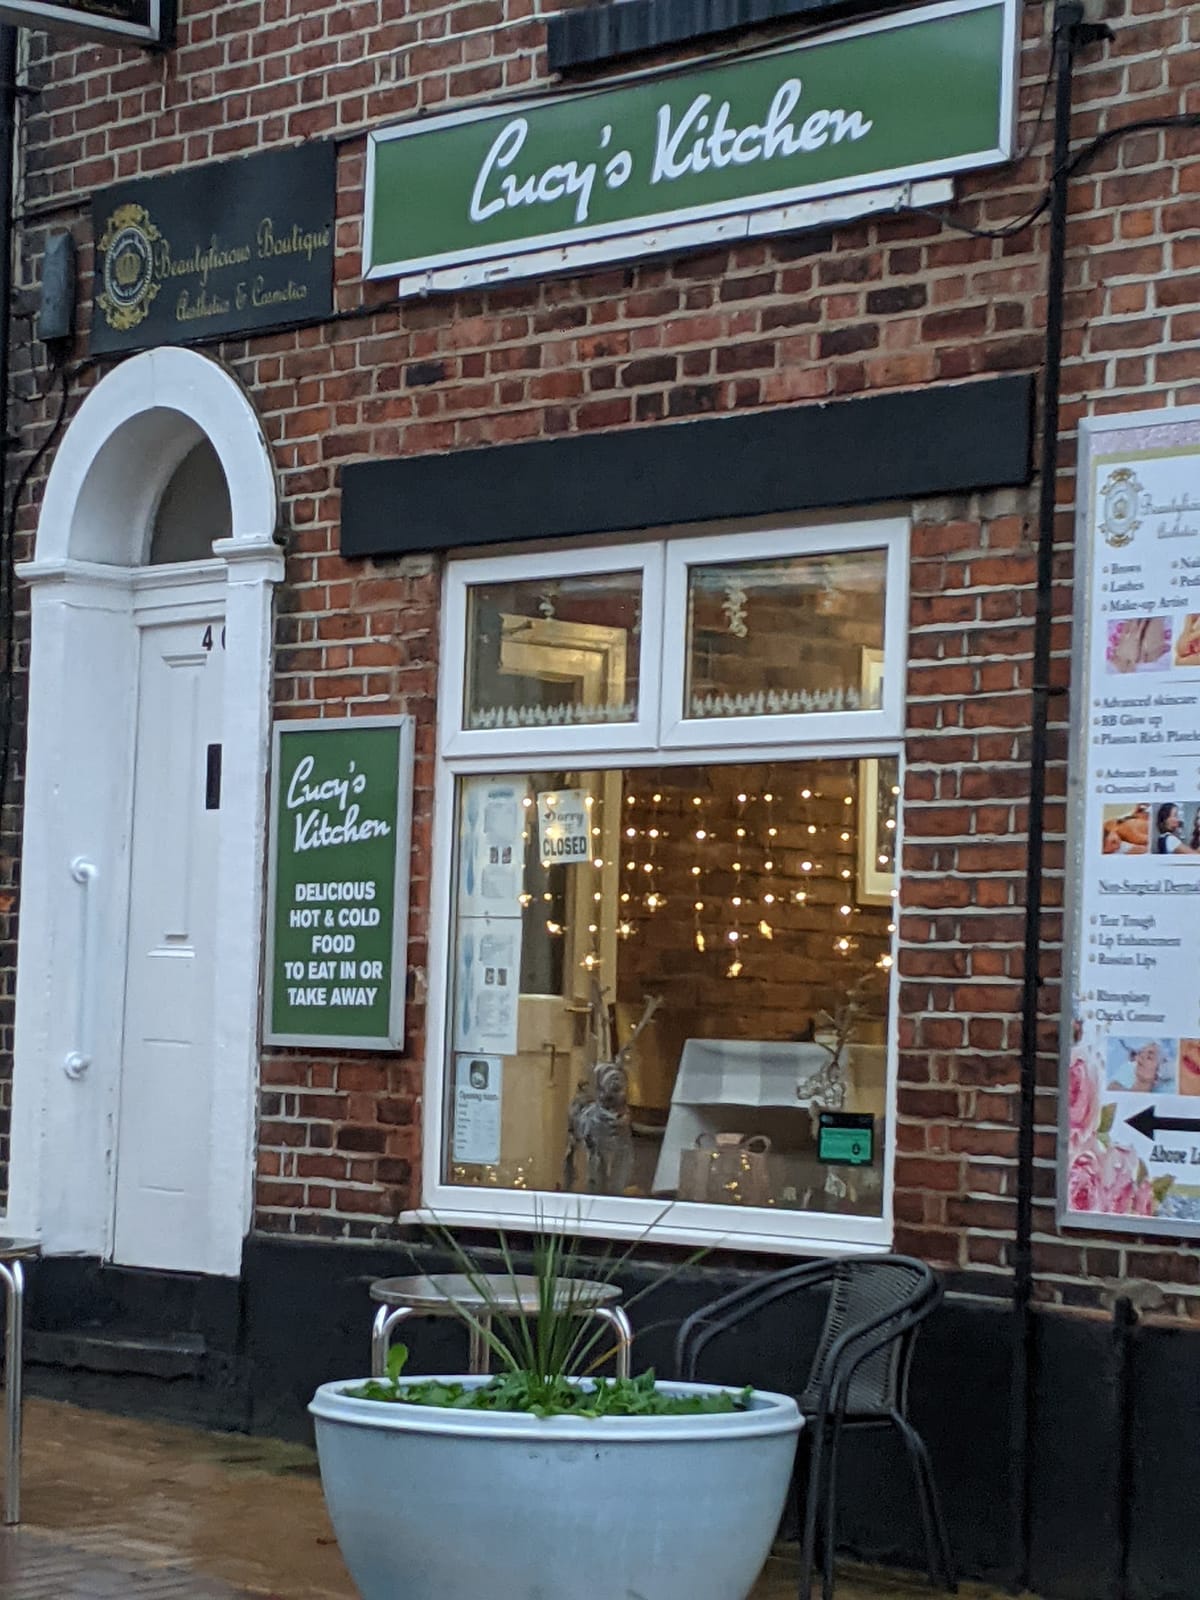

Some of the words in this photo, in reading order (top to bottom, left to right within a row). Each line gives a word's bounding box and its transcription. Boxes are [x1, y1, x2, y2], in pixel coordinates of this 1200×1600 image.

[470, 118, 632, 224] Lucy's
[650, 78, 873, 185] Kitchen
[256, 216, 331, 262] Boutique
[287, 755, 367, 810] Lucy's
[293, 803, 391, 853] Kitchen
[542, 836, 587, 857] CLOSED
[295, 880, 376, 902] DELICIOUS
[290, 909, 321, 928] HOT
[324, 909, 335, 928] &
[338, 907, 380, 928] COLD
[312, 934, 356, 955] FOOD
[285, 961, 305, 980] TO
[308, 961, 337, 980] EAT
[340, 960, 356, 980] IN
[360, 960, 383, 980] OR
[288, 987, 327, 1007] TAKE
[330, 987, 378, 1006] AWAY
[1150, 1144, 1187, 1164] Above
